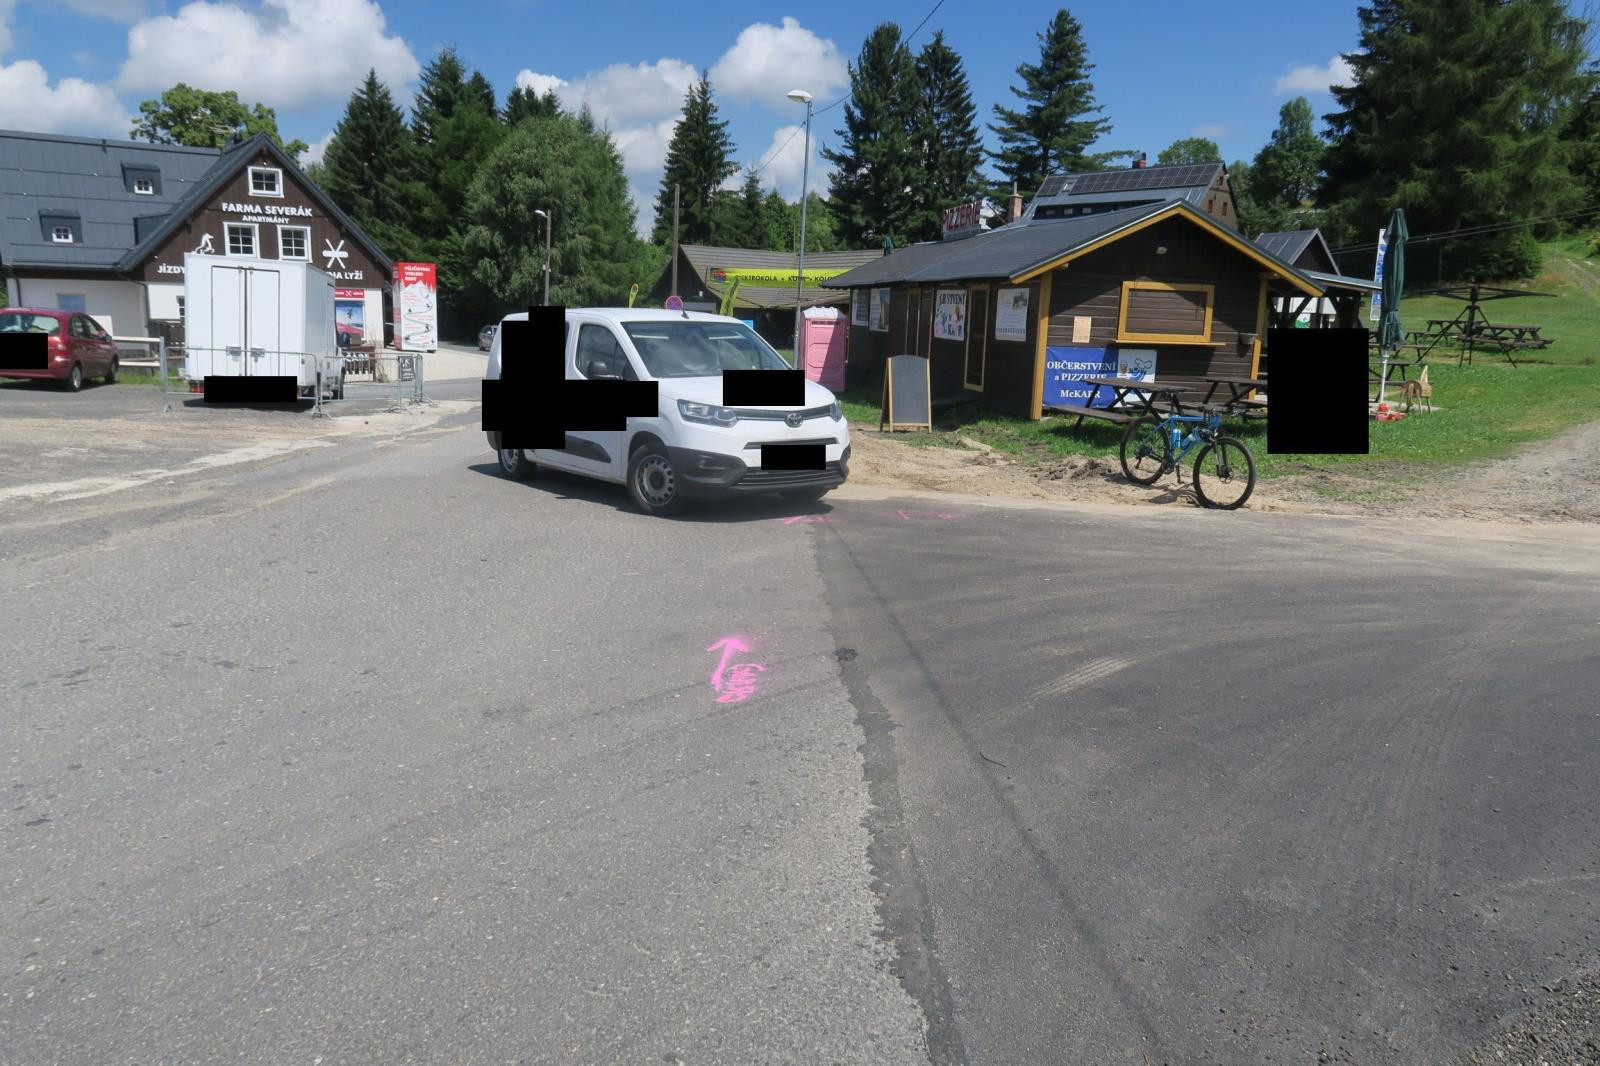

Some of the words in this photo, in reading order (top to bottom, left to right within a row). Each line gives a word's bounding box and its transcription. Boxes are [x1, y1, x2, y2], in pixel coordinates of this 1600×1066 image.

[222, 202, 263, 215] FARMA
[264, 205, 313, 217] SEVERÁK
[242, 215, 290, 225] APARTMÁNY
[344, 270, 363, 280] LYŽÍ
[1046, 360, 1117, 371] OBČERSTVENÍ
